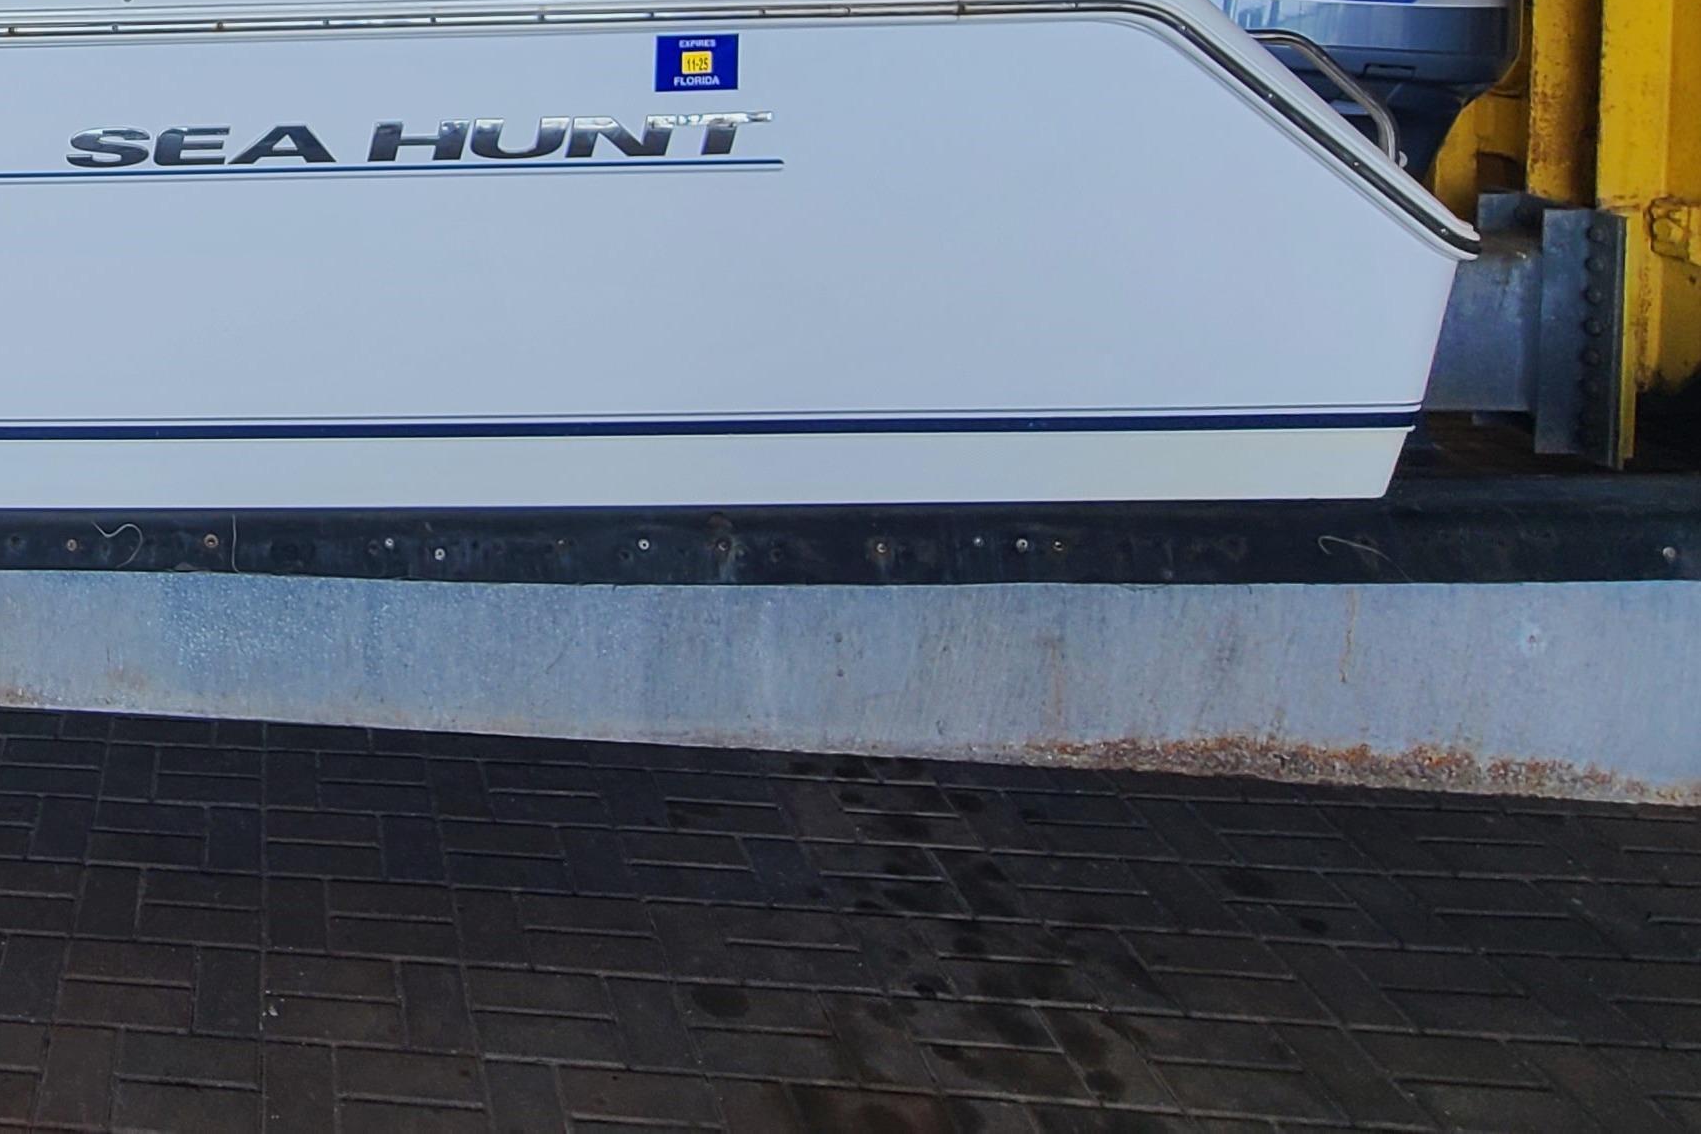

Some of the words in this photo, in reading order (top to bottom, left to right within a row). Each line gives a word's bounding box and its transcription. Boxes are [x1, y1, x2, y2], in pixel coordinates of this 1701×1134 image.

[679, 39, 717, 48] EXPIRES
[686, 57, 709, 72] 11-25
[673, 75, 721, 86] FLORIDA
[66, 123, 337, 167] SEA
[366, 110, 775, 162] HUNT
